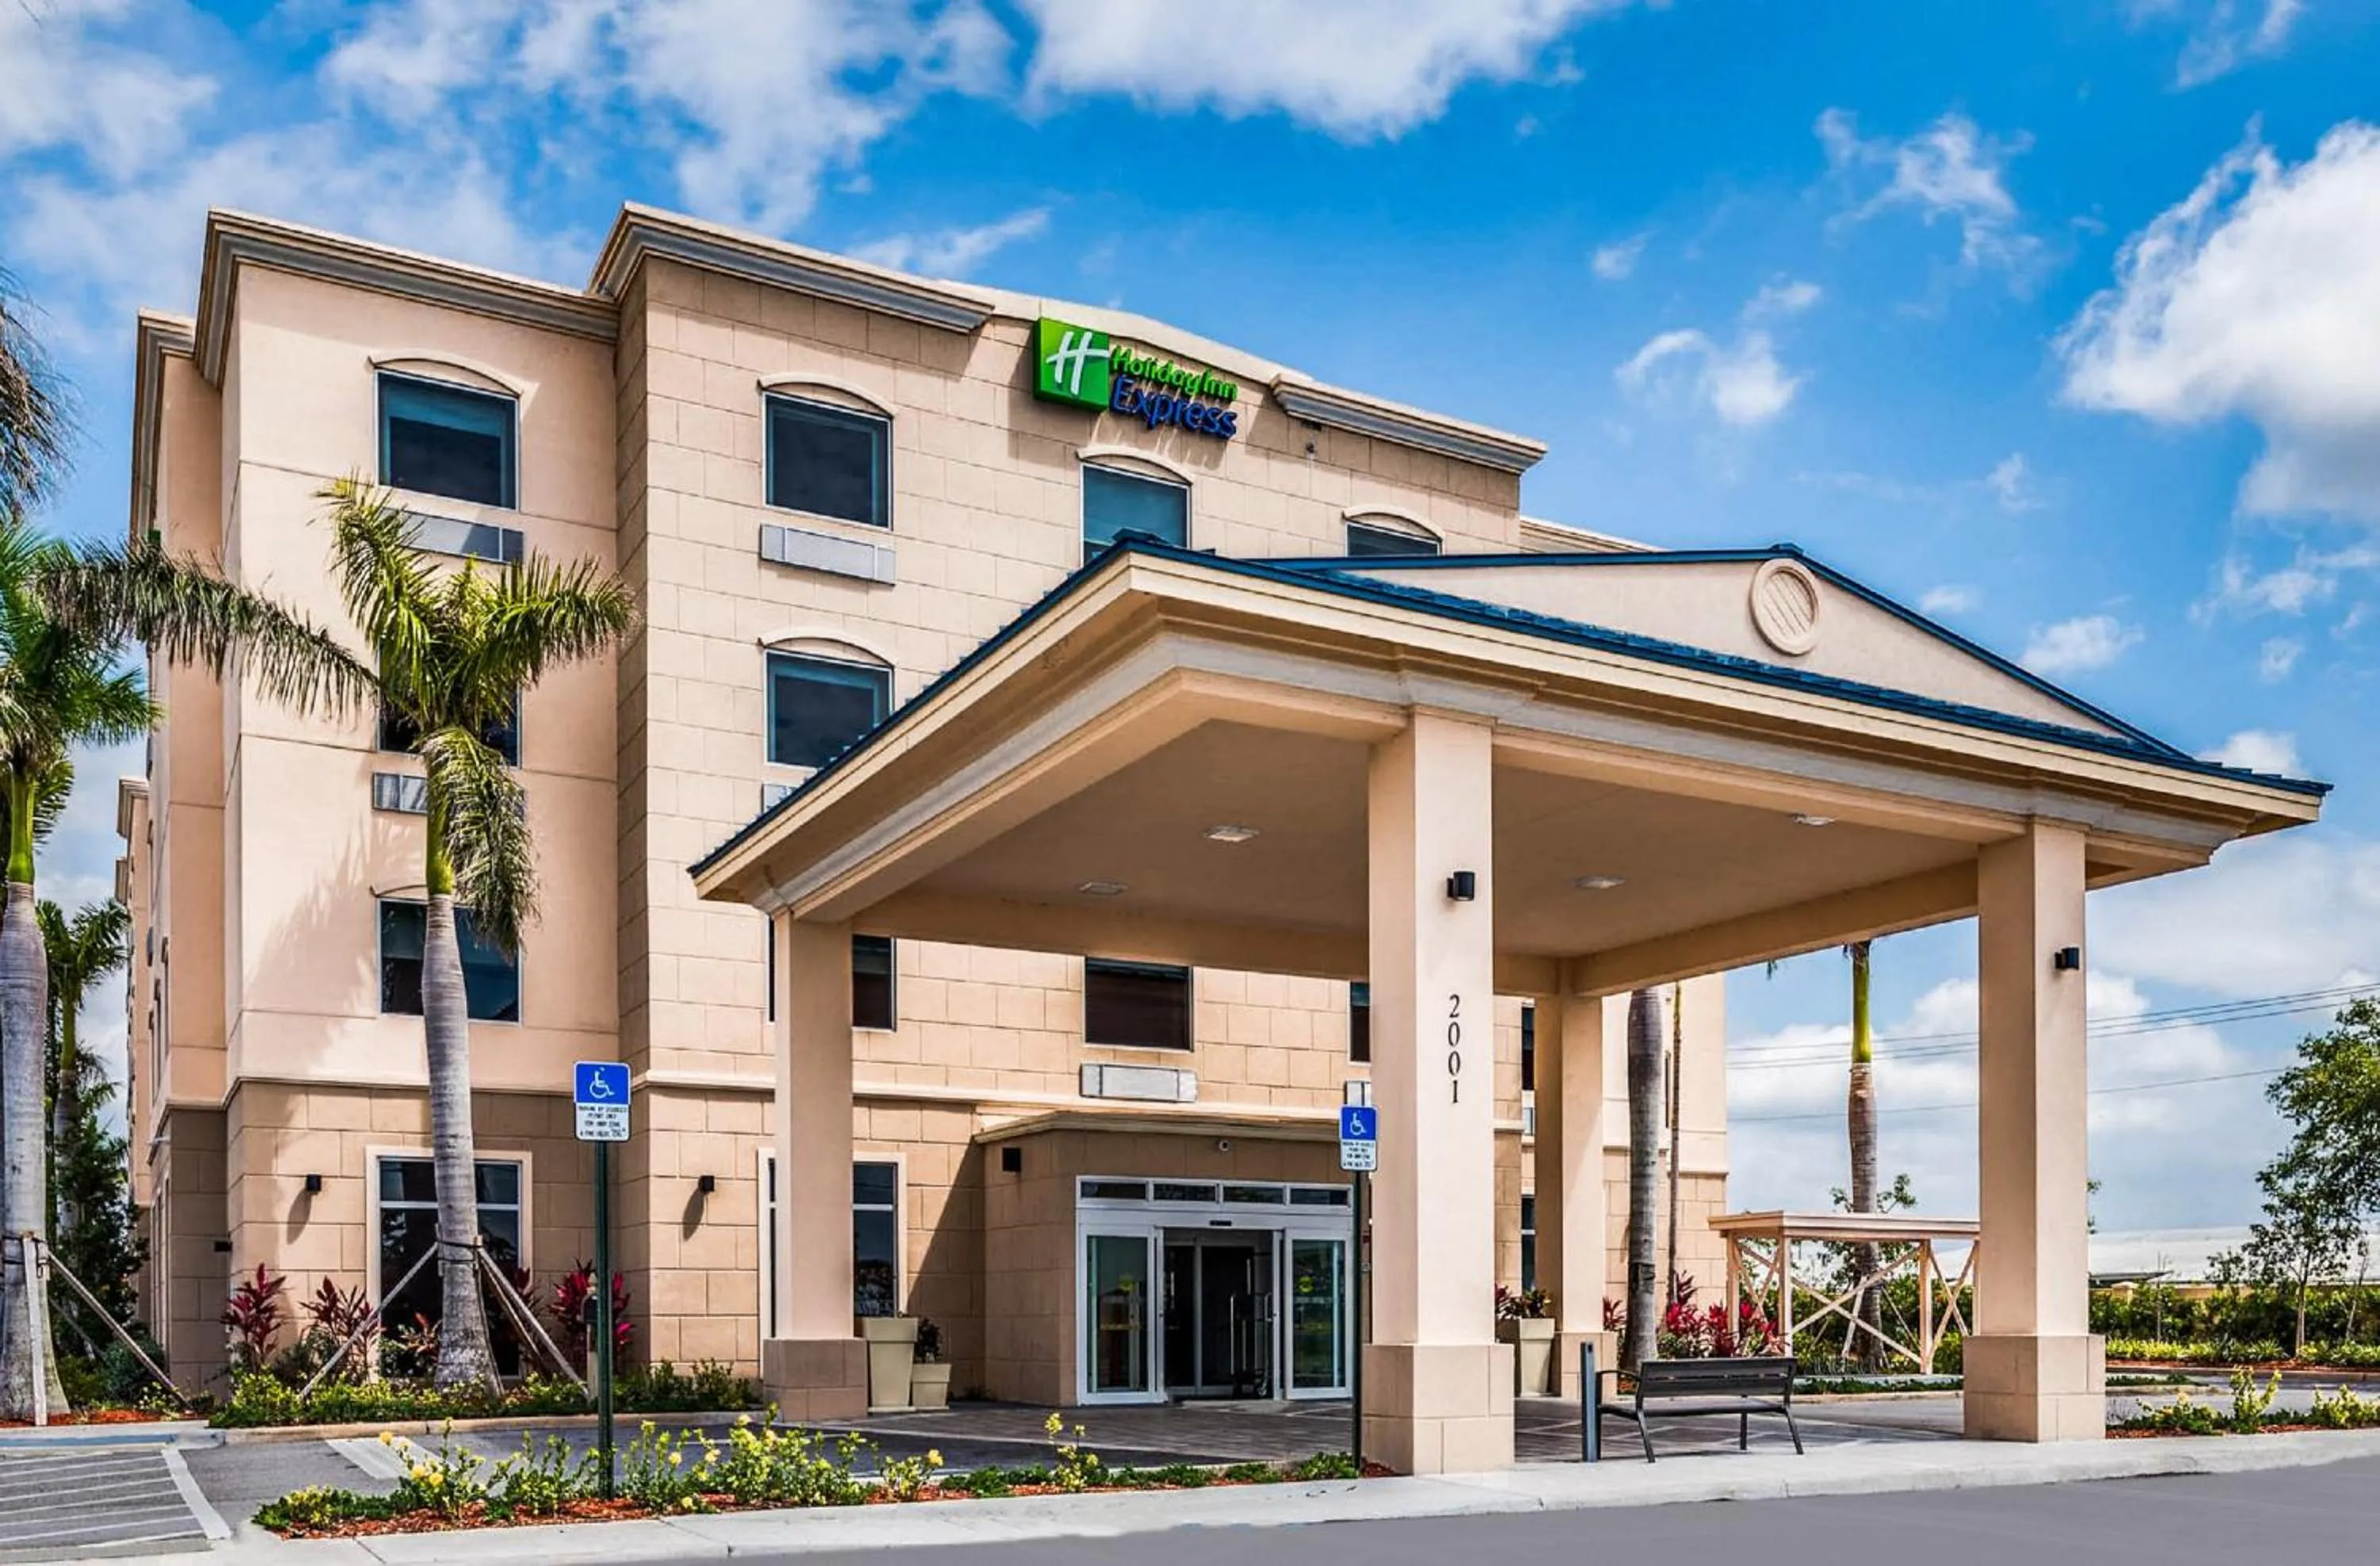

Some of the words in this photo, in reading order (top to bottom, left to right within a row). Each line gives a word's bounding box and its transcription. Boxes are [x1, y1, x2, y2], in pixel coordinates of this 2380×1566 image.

[1111, 344, 1200, 395] Holiday
[1201, 368, 1238, 401] Inn
[1111, 374, 1238, 439] Express
[1448, 993, 1461, 1103] 2001
